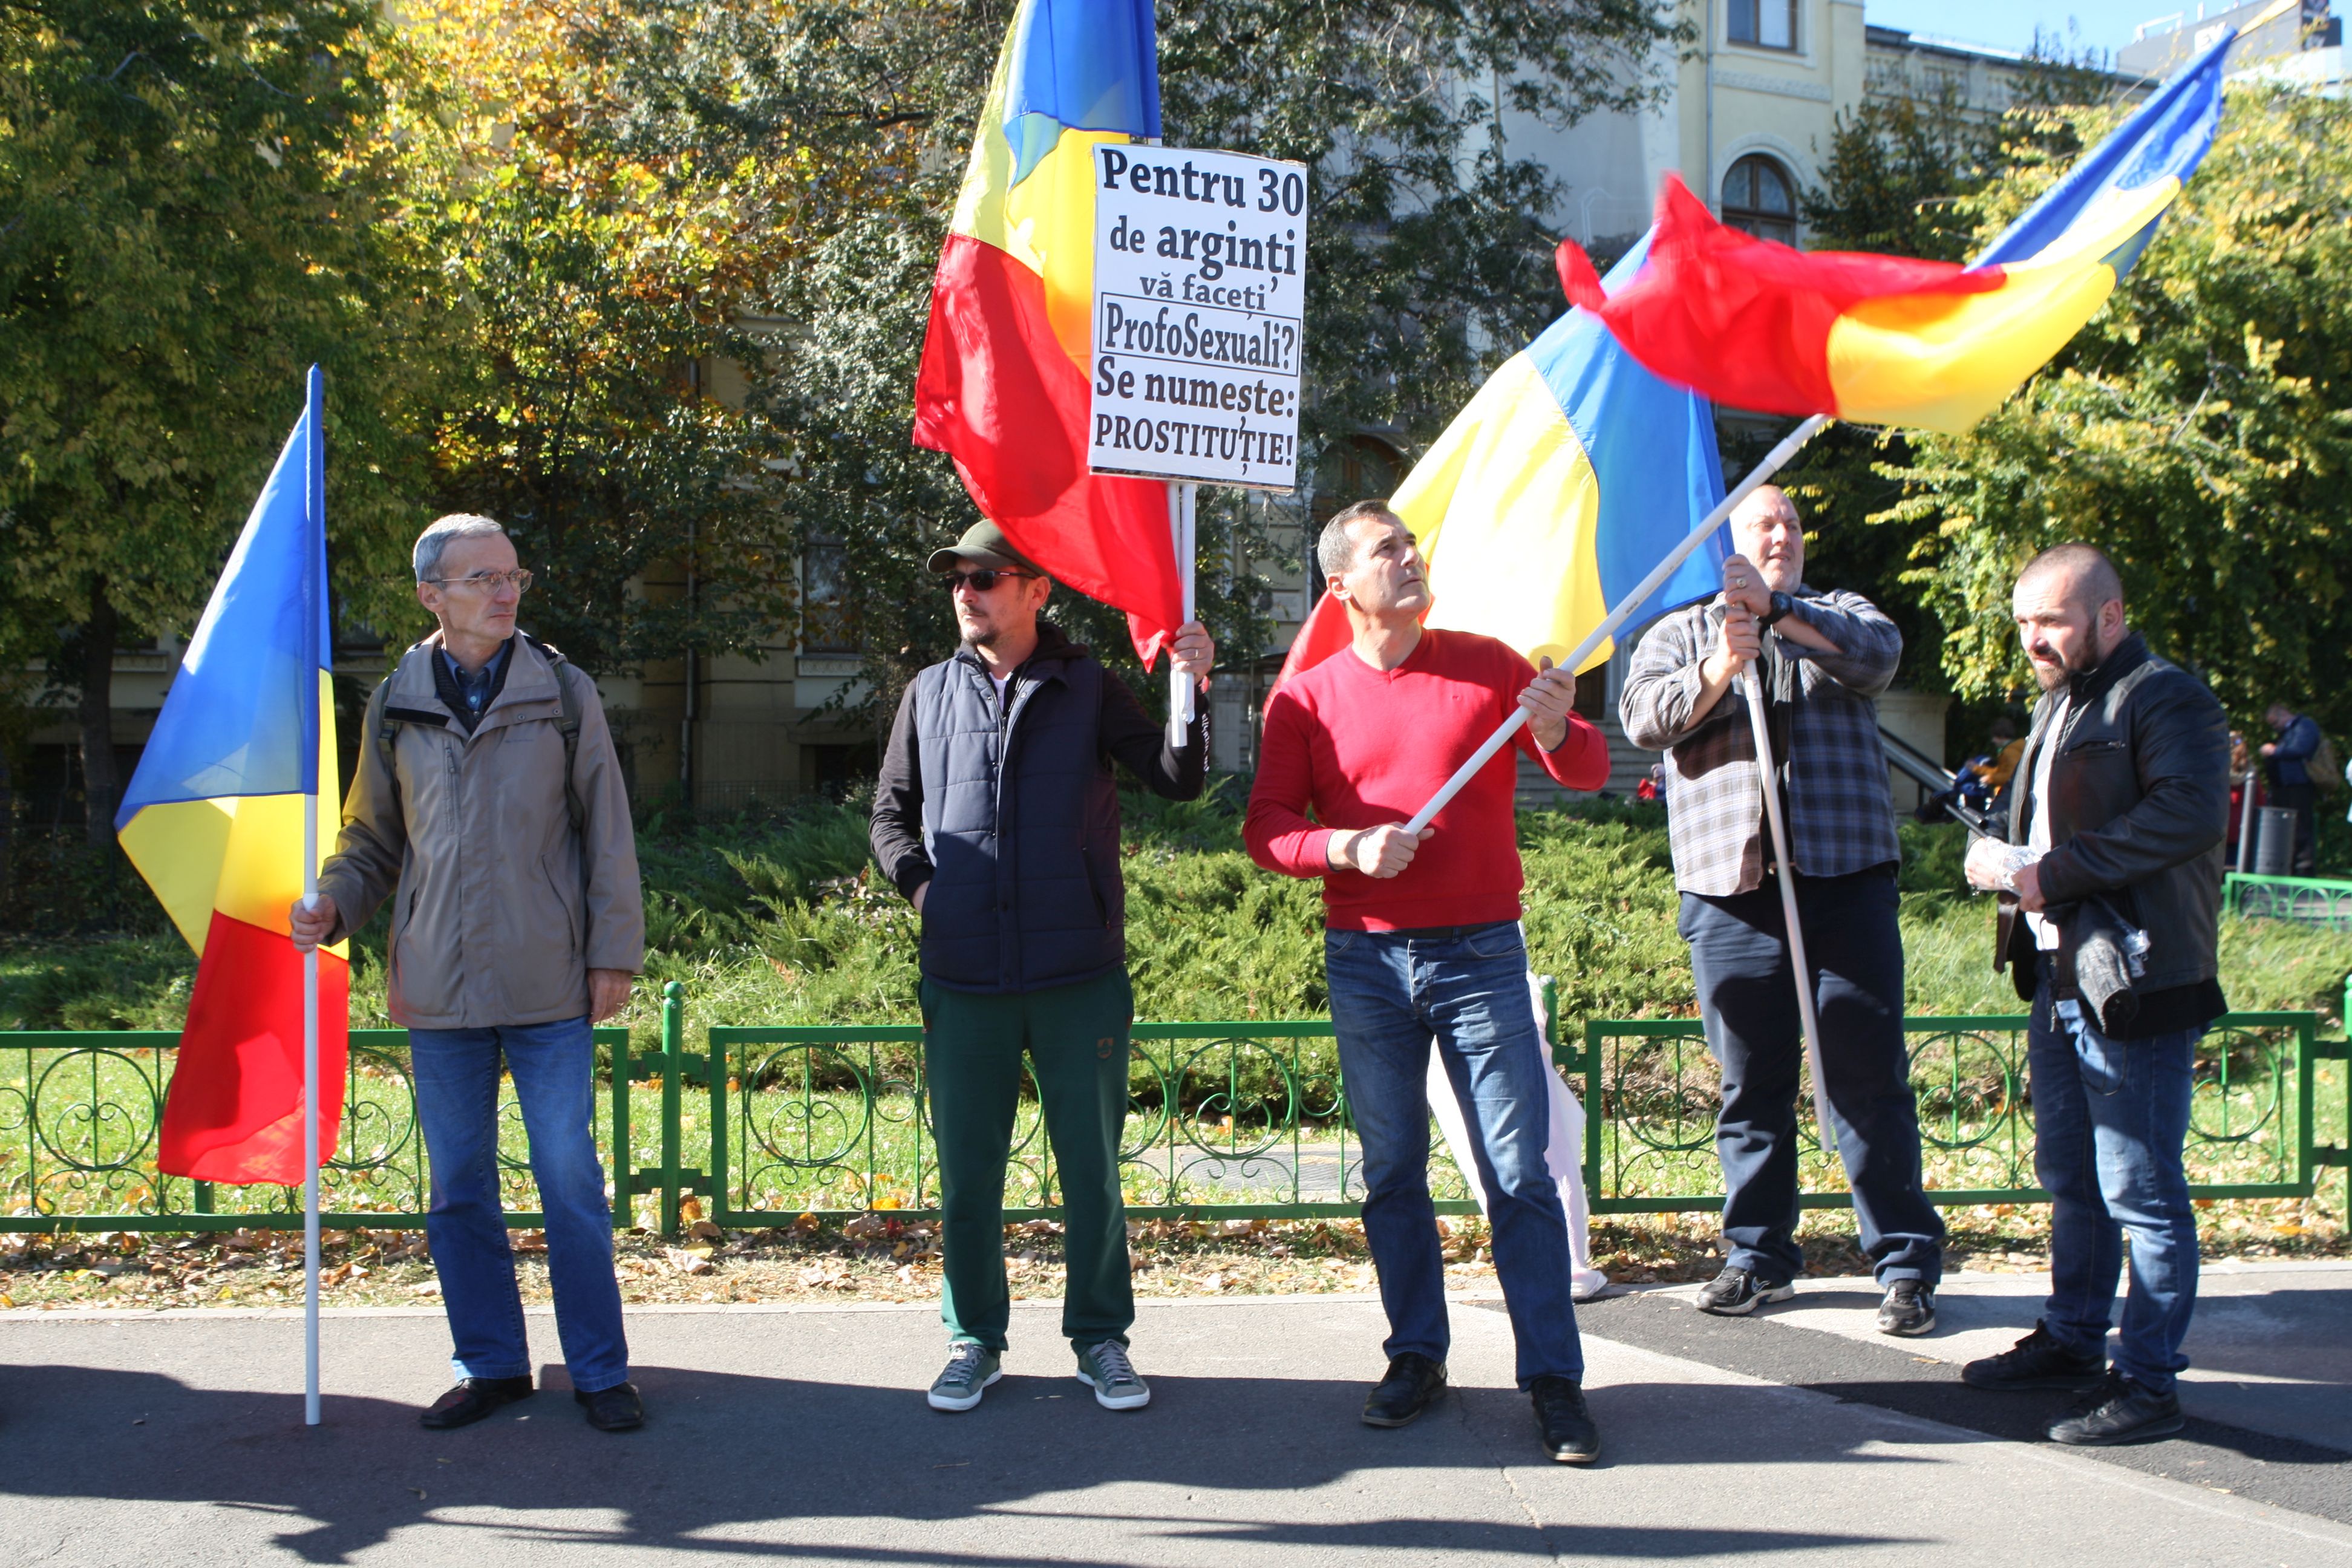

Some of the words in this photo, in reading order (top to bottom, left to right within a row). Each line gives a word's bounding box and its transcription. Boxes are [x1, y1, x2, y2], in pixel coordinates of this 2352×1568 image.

[1101, 149, 1246, 209] Pentru
[1258, 168, 1304, 217] 30
[1110, 215, 1145, 253] de
[1157, 220, 1296, 293] arginți
[1140, 272, 1174, 298] vă
[1182, 273, 1266, 320] faceți
[1105, 302, 1295, 370] ProfoSexuali?
[1096, 356, 1135, 399] Se
[1145, 373, 1295, 430] numește:
[1095, 414, 1293, 475] PROSTITUȚIE!
